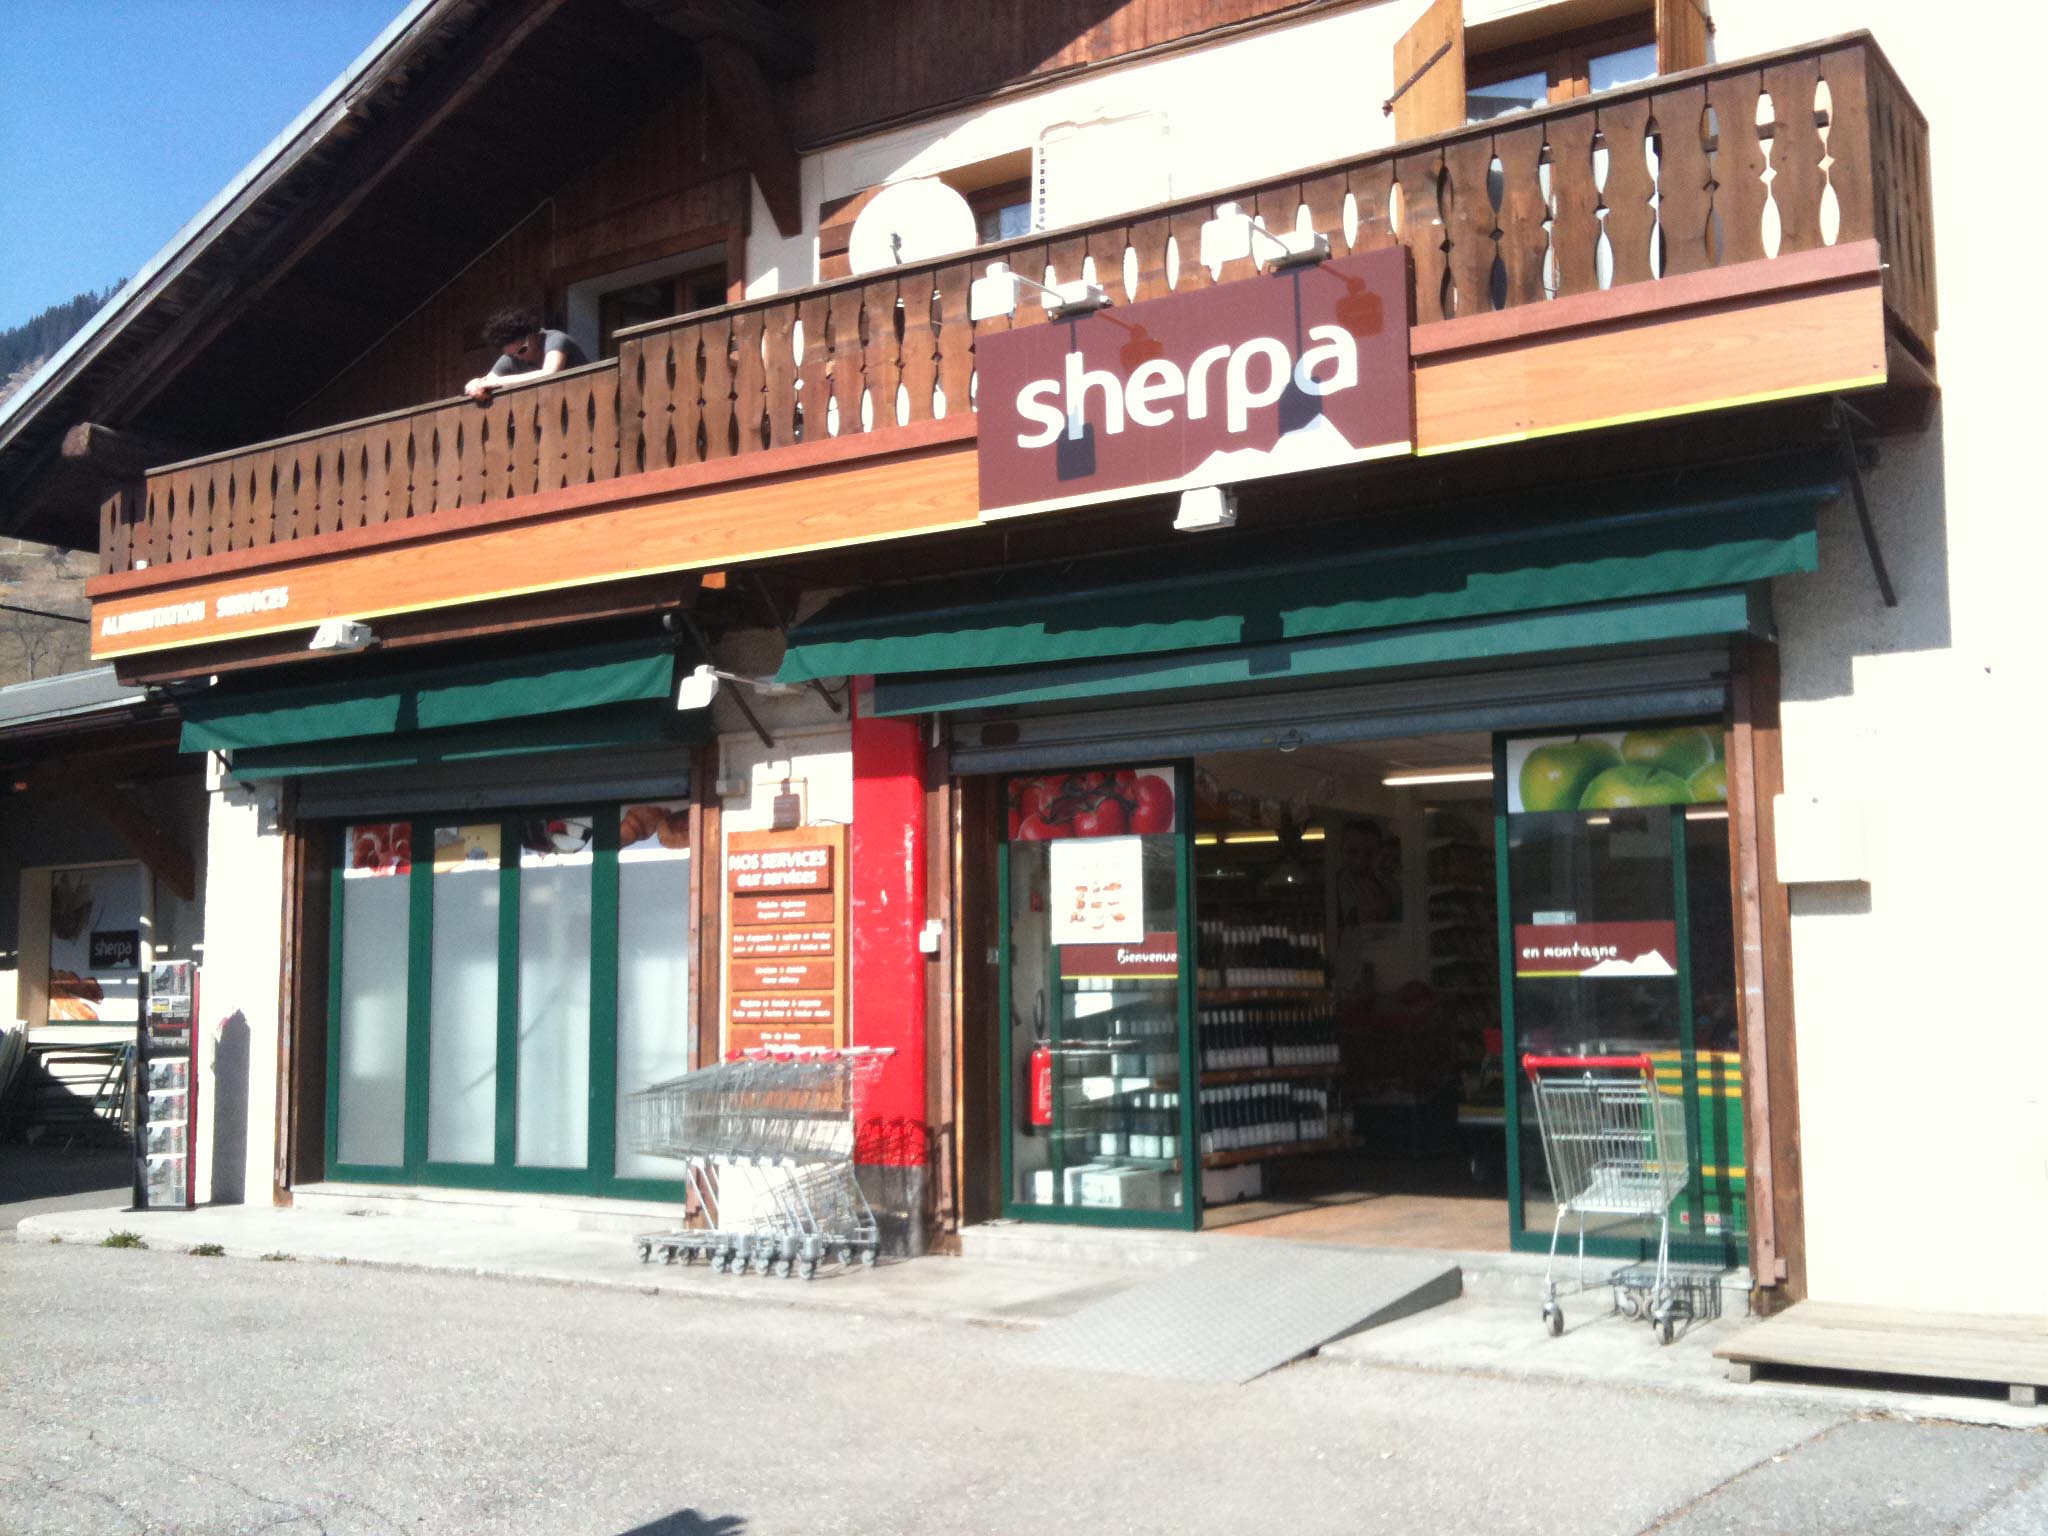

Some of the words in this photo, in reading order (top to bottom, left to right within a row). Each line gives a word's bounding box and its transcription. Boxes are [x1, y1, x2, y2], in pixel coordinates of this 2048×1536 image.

[1016, 325, 1358, 448] sherpa
[216, 587, 289, 617] SERVICES
[728, 854, 759, 870] NOS
[761, 850, 827, 869] SERVICES
[94, 938, 132, 957] sherpa
[1117, 948, 1177, 964] Bienvenue
[1522, 947, 1540, 958] en
[1543, 941, 1617, 961] montagne
